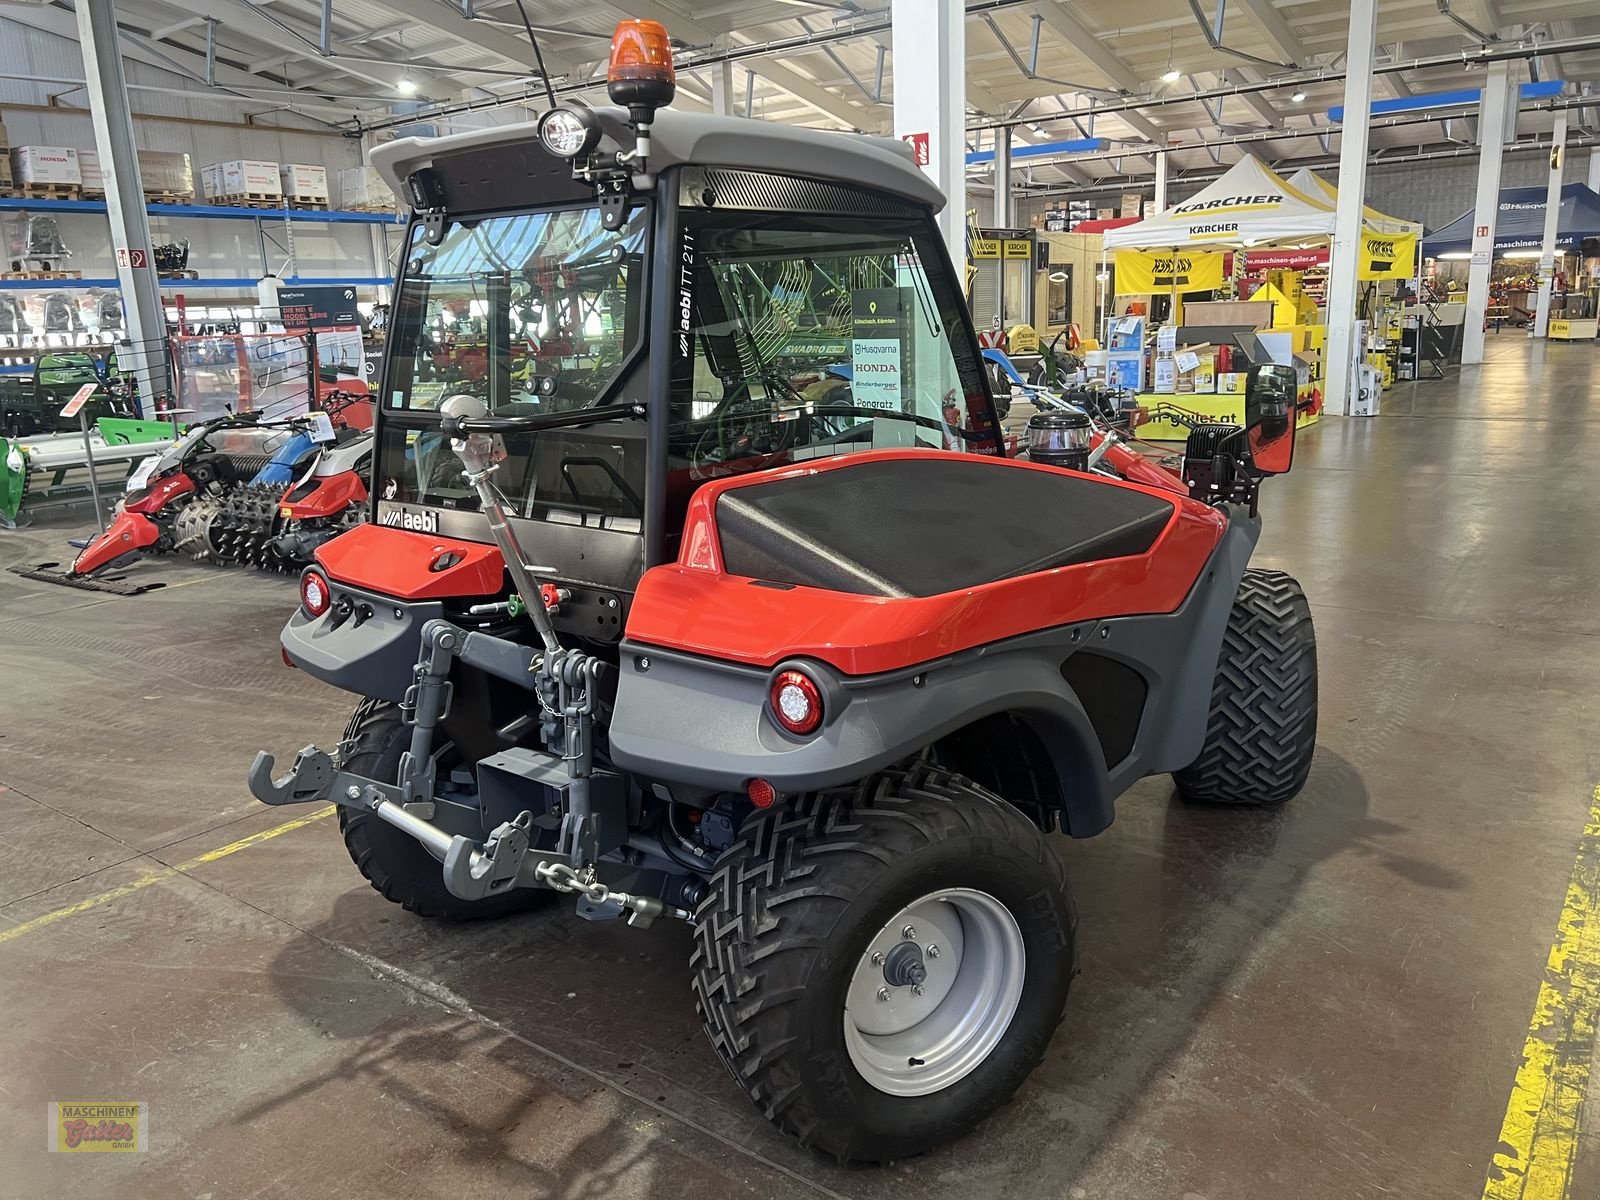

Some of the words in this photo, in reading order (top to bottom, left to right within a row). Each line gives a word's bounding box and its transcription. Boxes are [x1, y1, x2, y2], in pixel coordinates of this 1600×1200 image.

[1174, 195, 1283, 214] KÄRCHER
[1189, 223, 1239, 234] KÄRCHER
[784, 345, 826, 354] SWADRO
[861, 344, 897, 355] Husqvarna
[855, 364, 898, 373] HONDA
[404, 511, 436, 533] aebi
